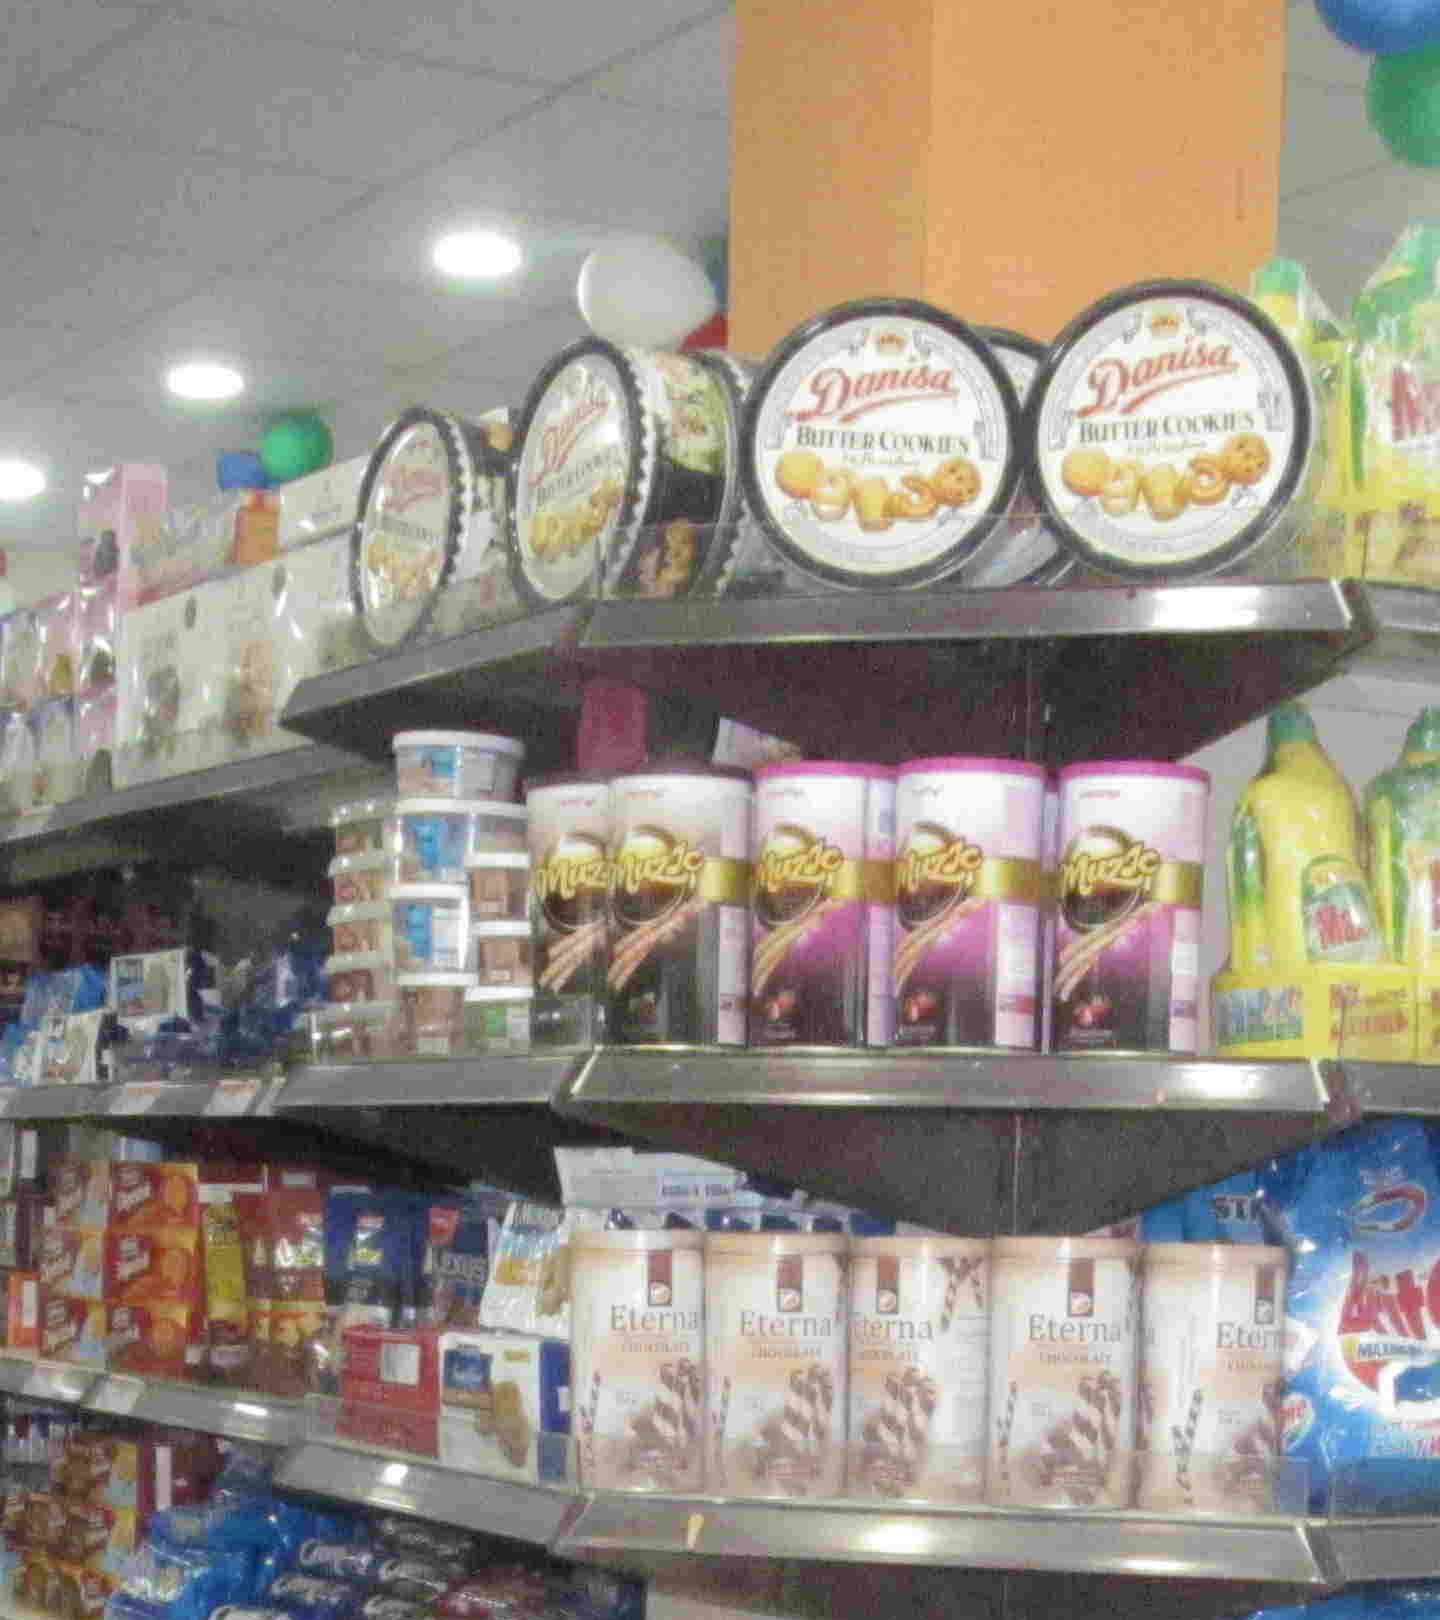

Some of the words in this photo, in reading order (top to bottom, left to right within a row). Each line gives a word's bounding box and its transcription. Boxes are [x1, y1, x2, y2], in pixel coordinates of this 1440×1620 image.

[1075, 336, 1240, 418] Danisa
[788, 365, 958, 422] Danisa
[797, 425, 876, 449] BUTTER
[879, 430, 970, 453] COOKIES
[1079, 417, 1158, 443] BUTTER
[1162, 411, 1255, 434] COOKIES
[610, 1304, 699, 1332] Eterna
[740, 1311, 834, 1338] Eterna
[1027, 1313, 1121, 1343] Eterna
